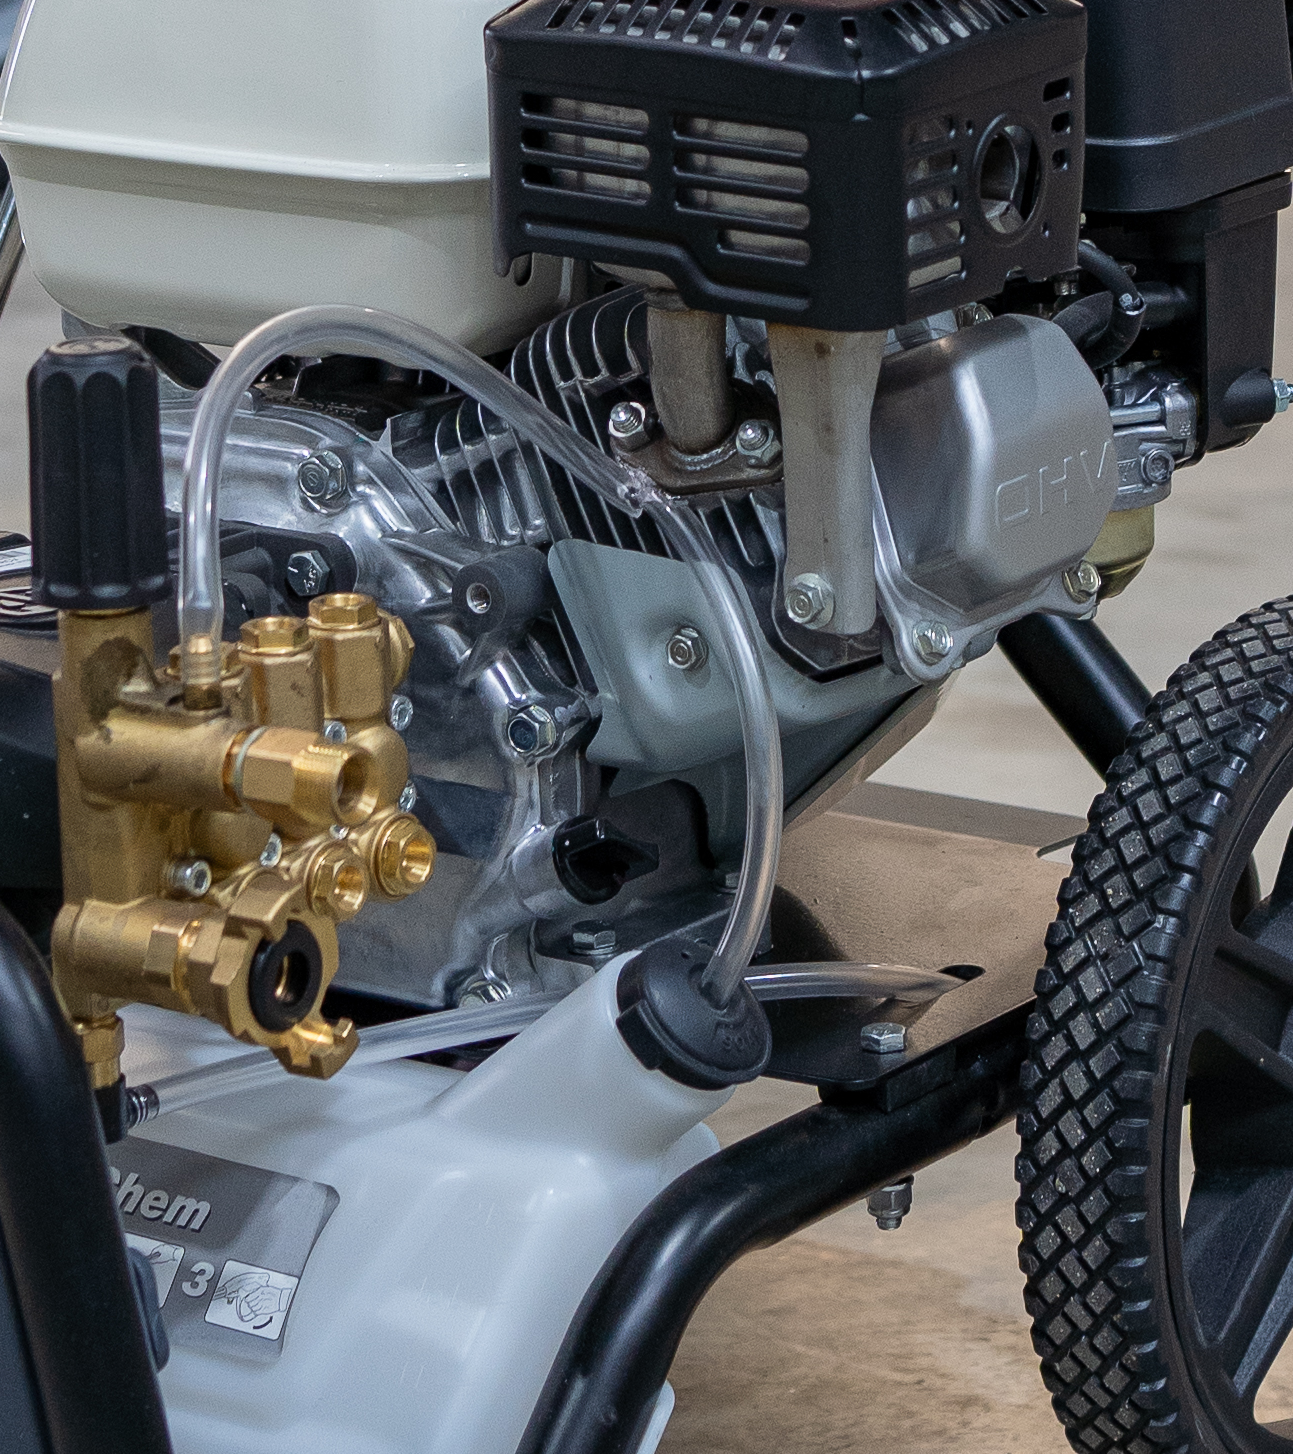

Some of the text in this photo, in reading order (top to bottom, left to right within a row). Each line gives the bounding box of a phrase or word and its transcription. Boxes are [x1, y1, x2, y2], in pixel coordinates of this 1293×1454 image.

[995, 439, 1112, 530] OHV
[109, 1165, 212, 1233] hem
[181, 1261, 215, 1298] 3
